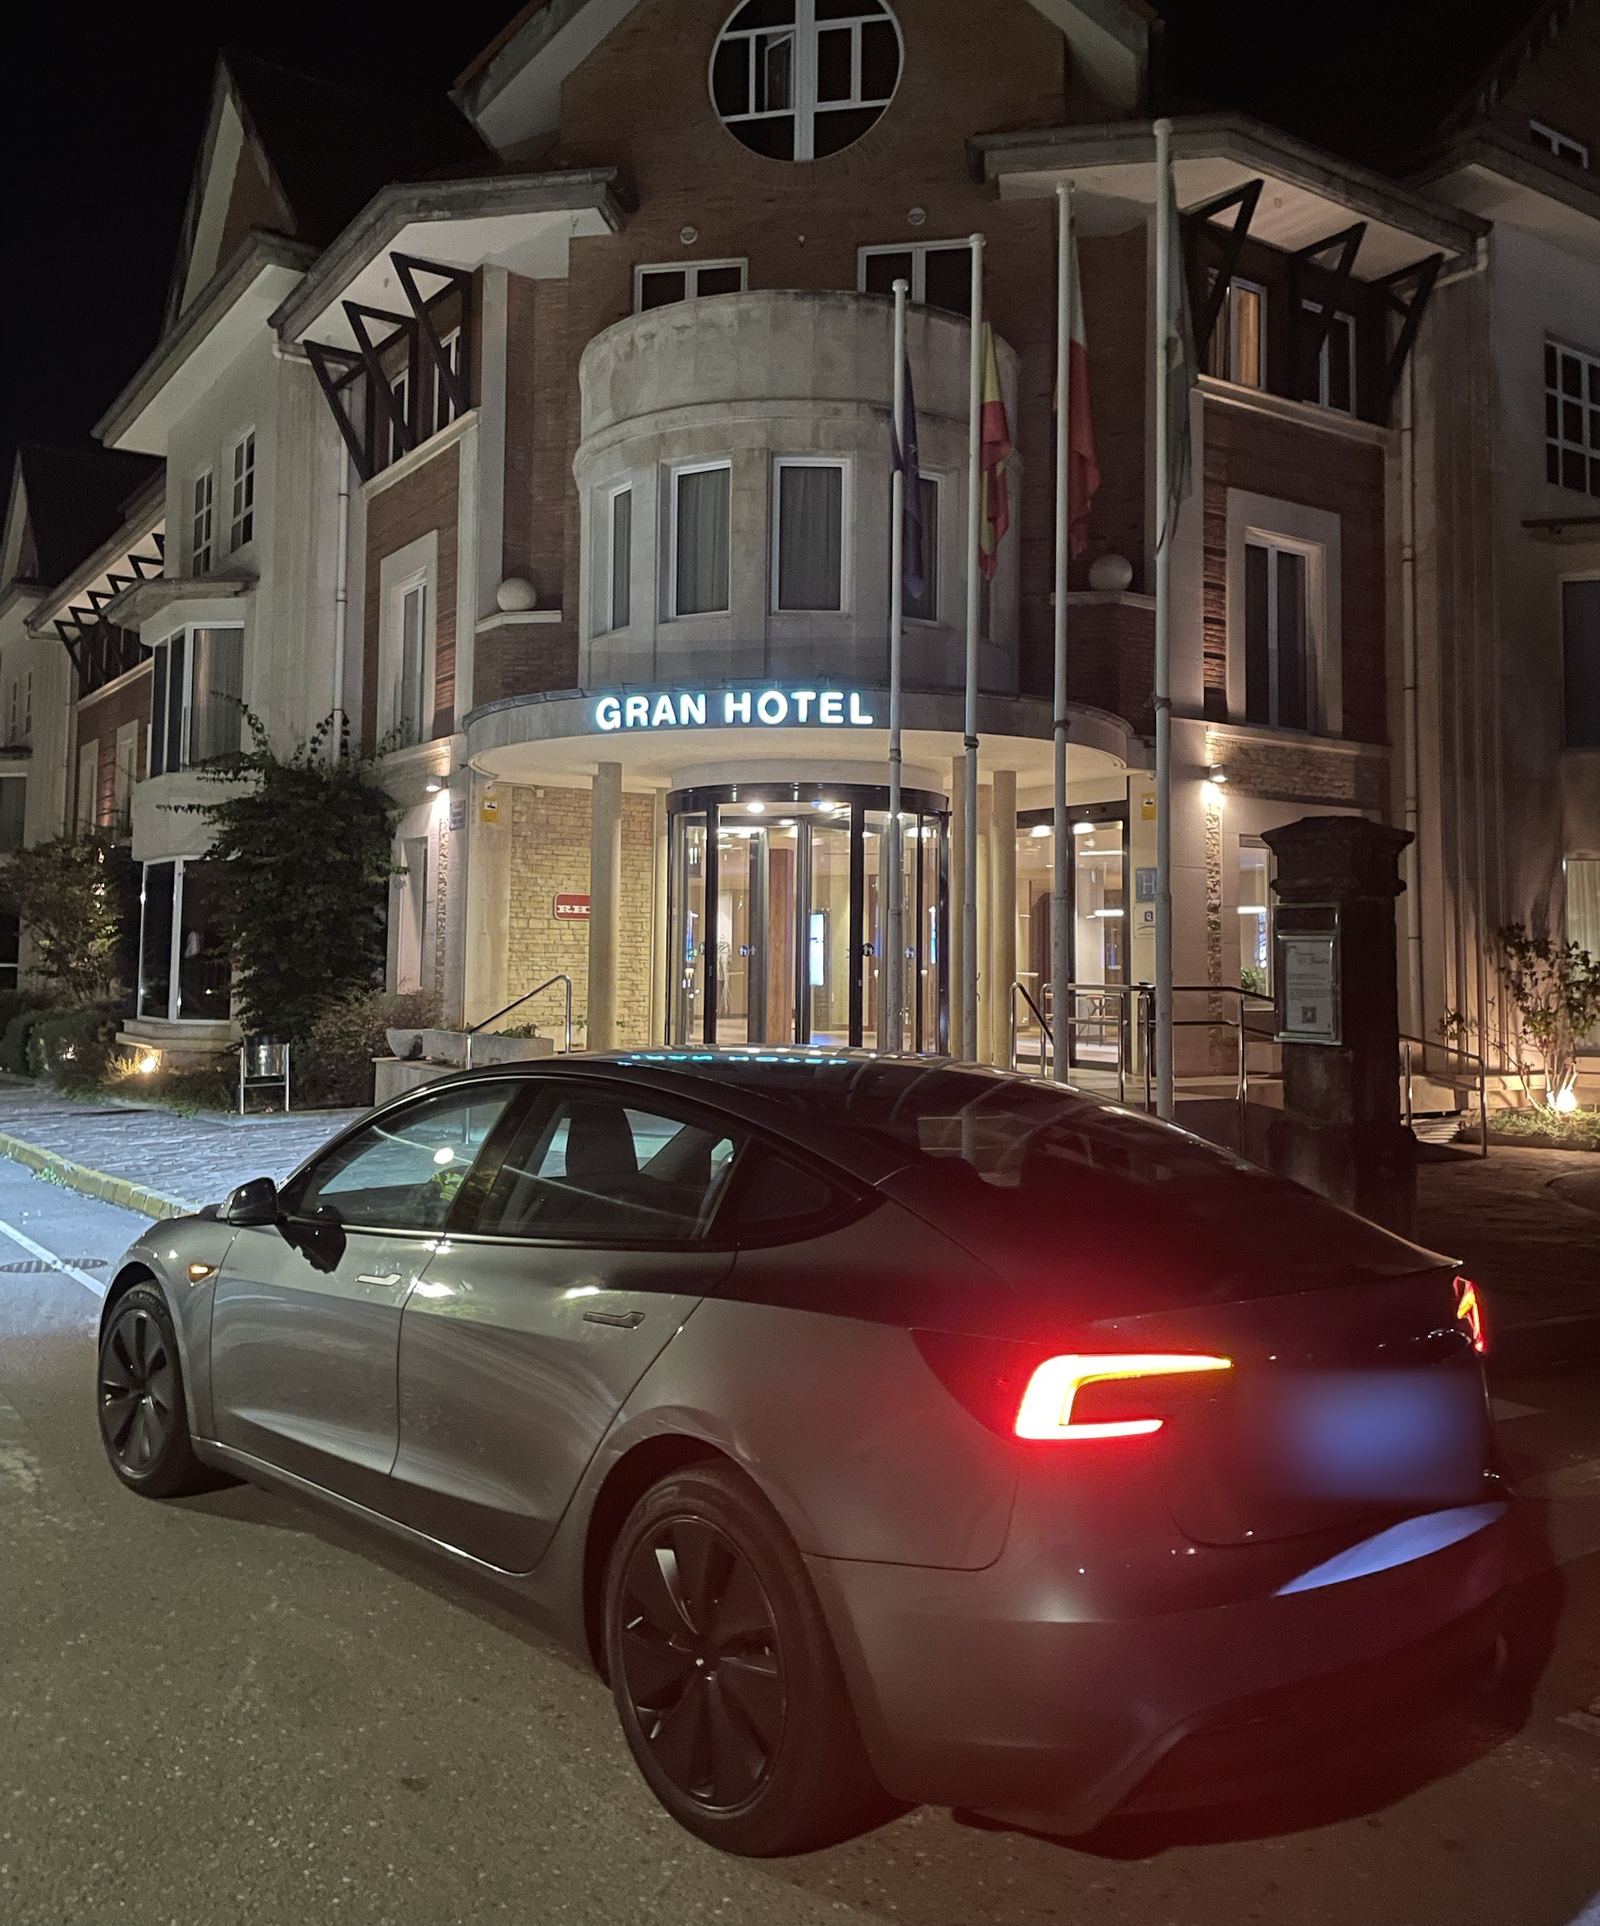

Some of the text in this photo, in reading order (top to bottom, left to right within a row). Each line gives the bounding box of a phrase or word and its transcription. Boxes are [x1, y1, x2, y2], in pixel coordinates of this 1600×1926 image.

[595, 690, 875, 731] GRAN HOTEL
[1142, 875, 1156, 895] H
